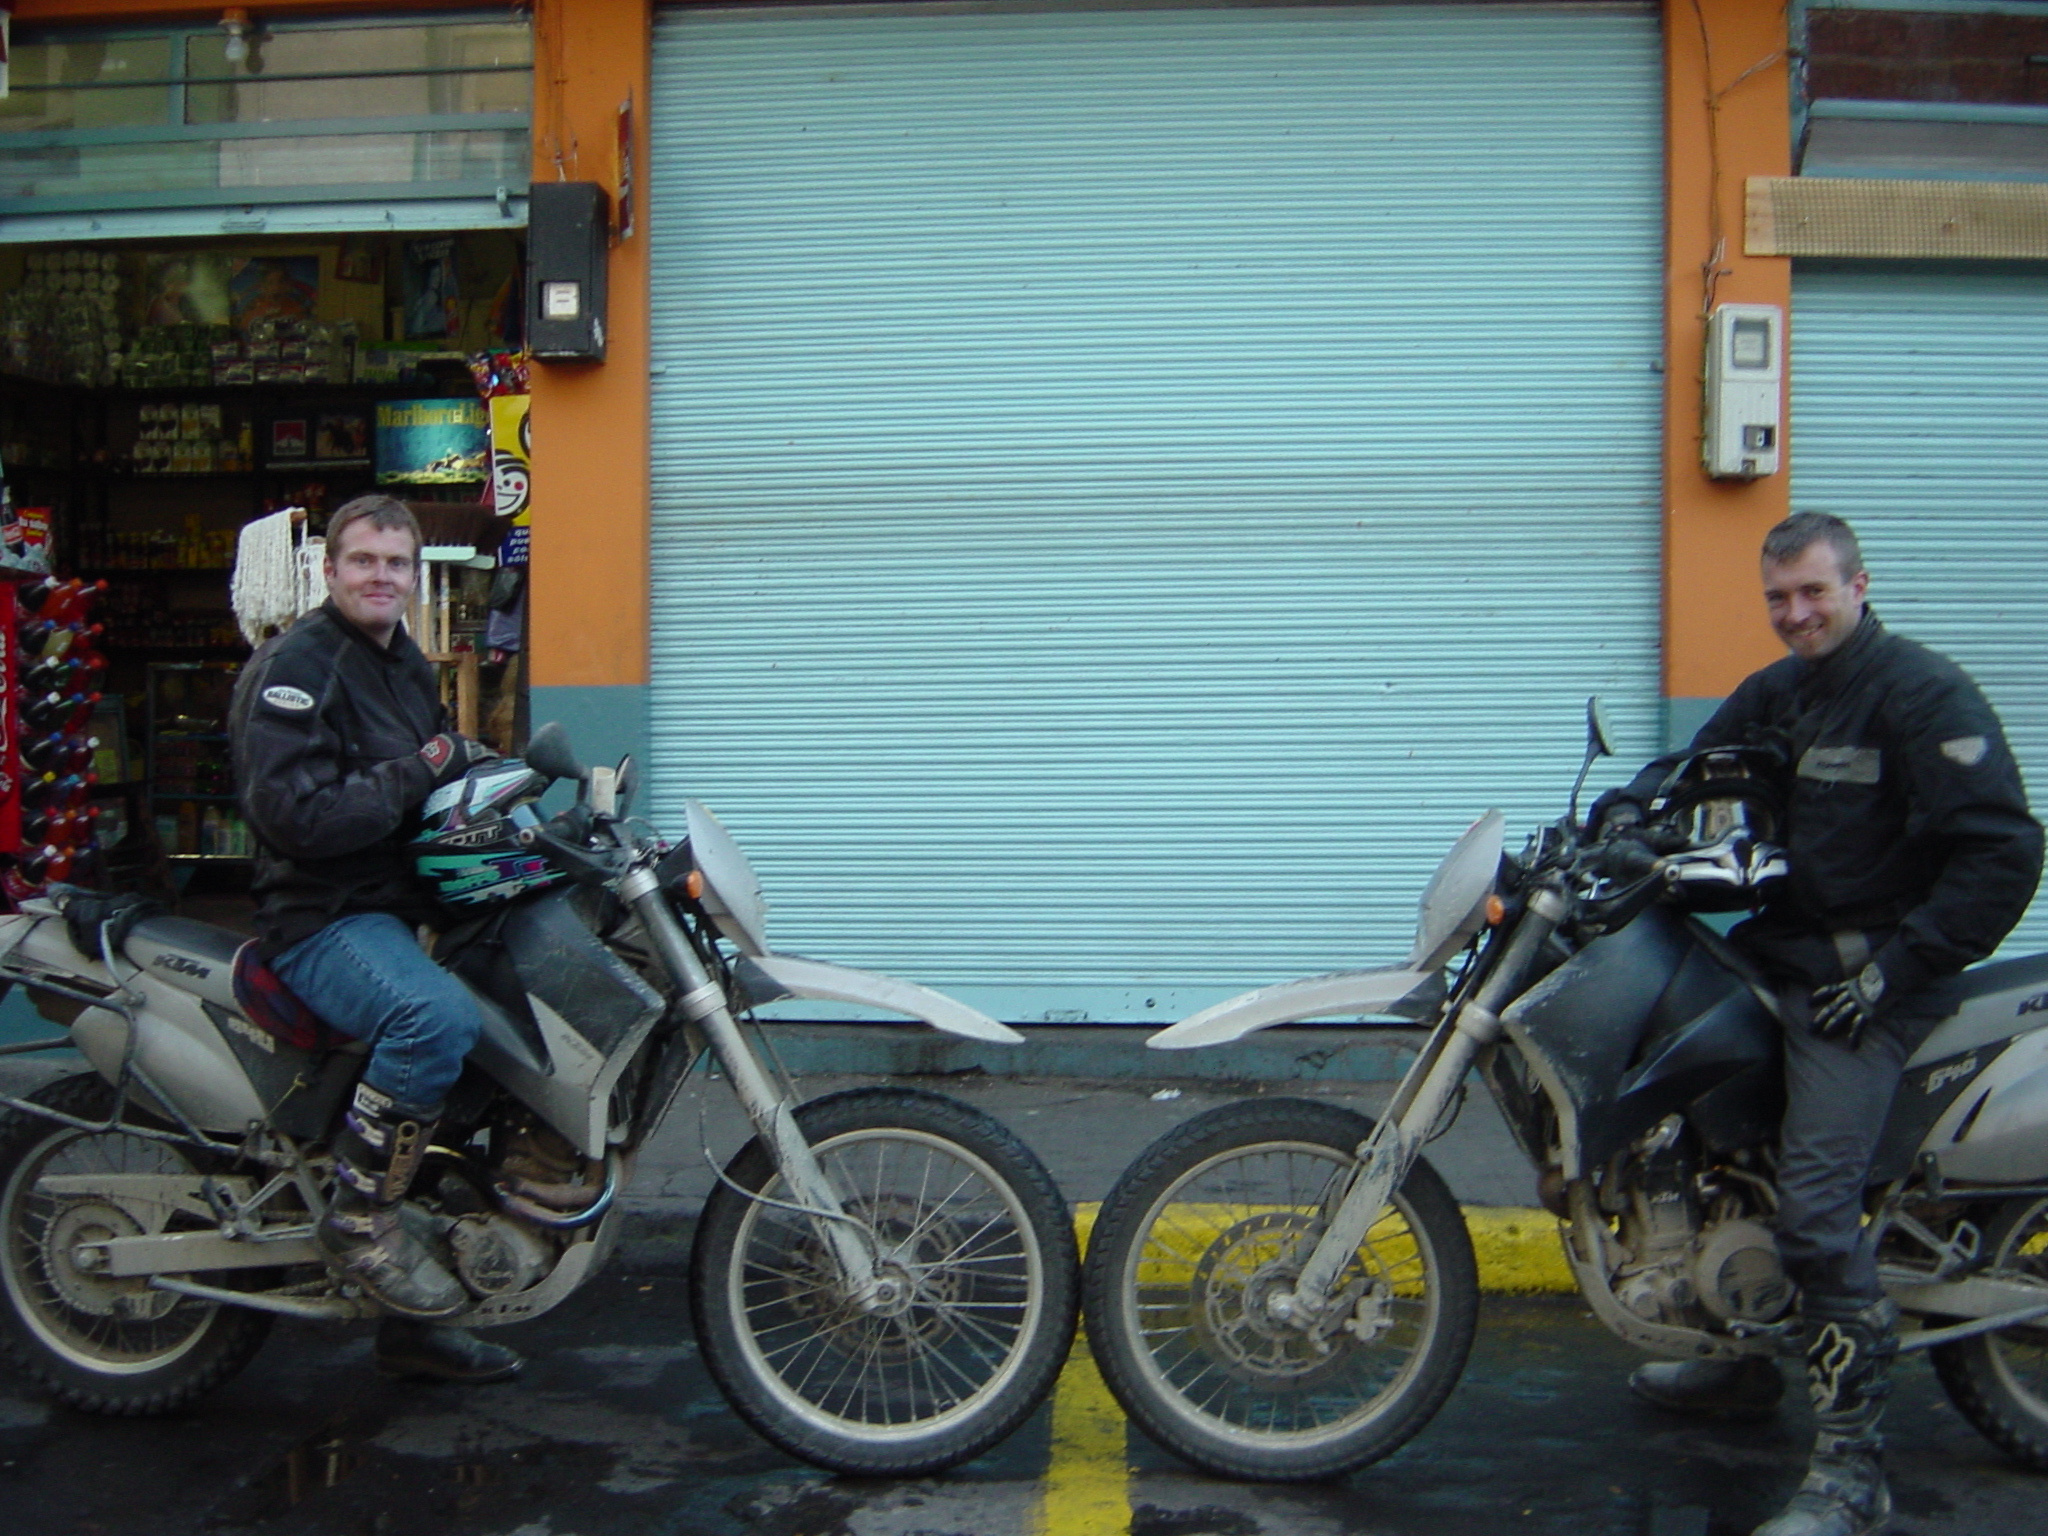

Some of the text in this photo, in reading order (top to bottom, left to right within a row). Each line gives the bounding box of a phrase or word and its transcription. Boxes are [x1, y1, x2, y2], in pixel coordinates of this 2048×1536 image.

[377, 402, 489, 428] Marlboro Lig
[152, 953, 212, 979] KTM
